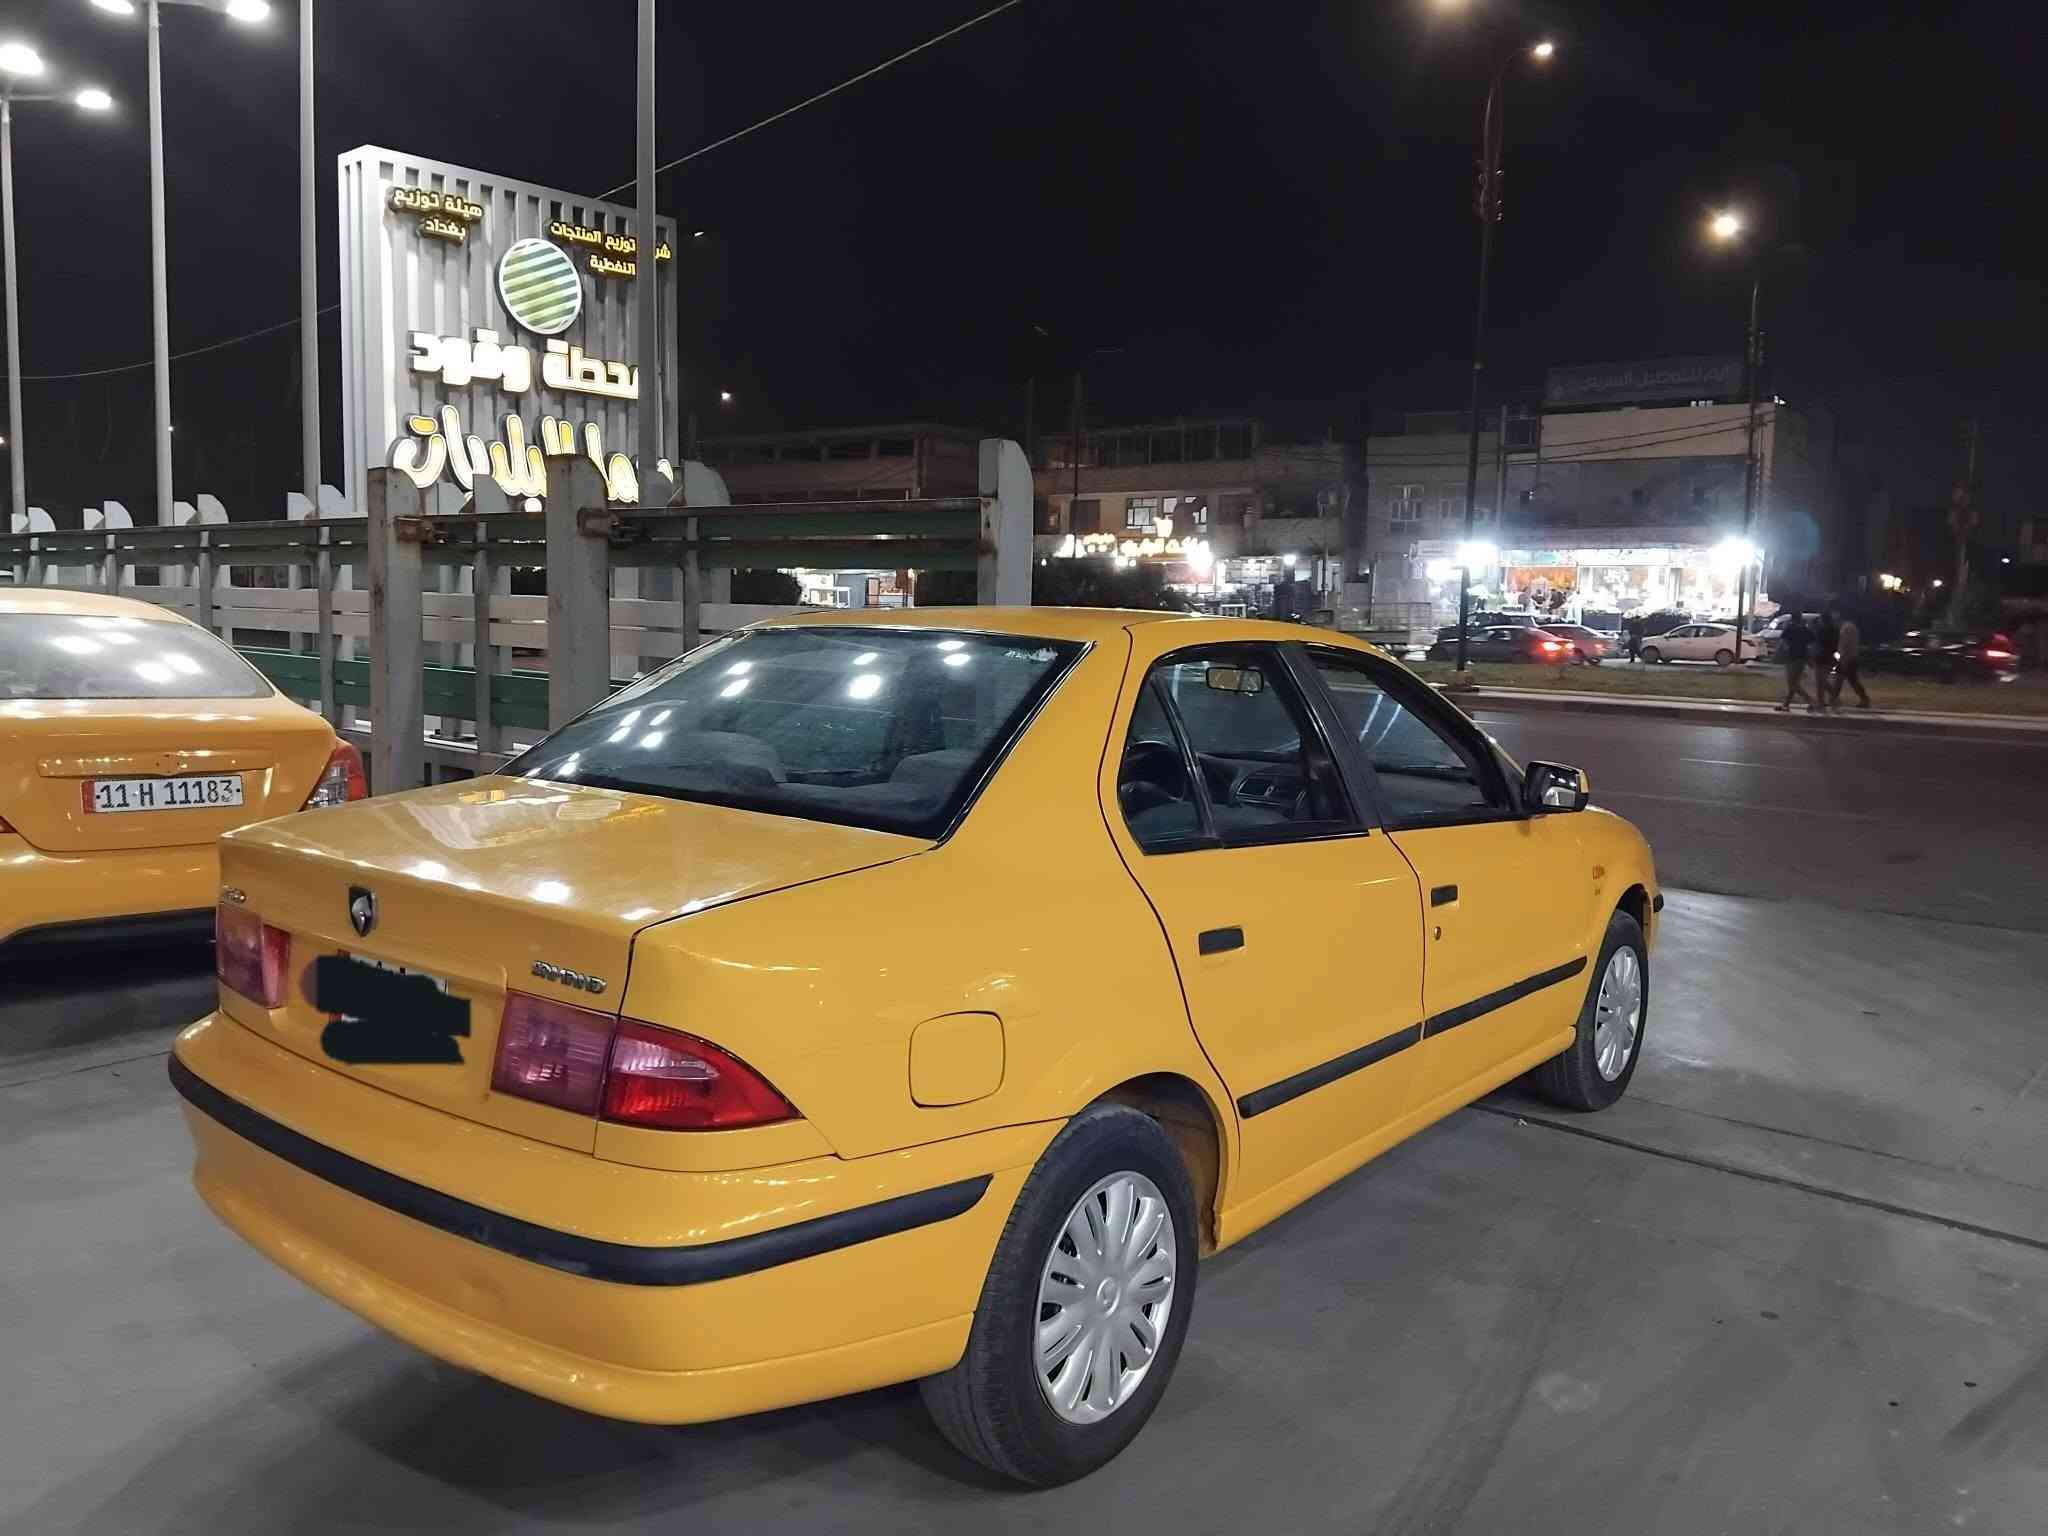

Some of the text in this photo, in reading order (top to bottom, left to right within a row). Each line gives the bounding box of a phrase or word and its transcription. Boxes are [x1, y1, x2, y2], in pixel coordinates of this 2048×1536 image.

[393, 189, 440, 209] توزيع
[425, 218, 467, 241] بغداد
[550, 221, 602, 243] المنتجات
[604, 235, 637, 254] توزيع
[589, 254, 637, 276] النفطية
[408, 327, 532, 393] وقود
[100, 779, 233, 808] 11 H 11183
